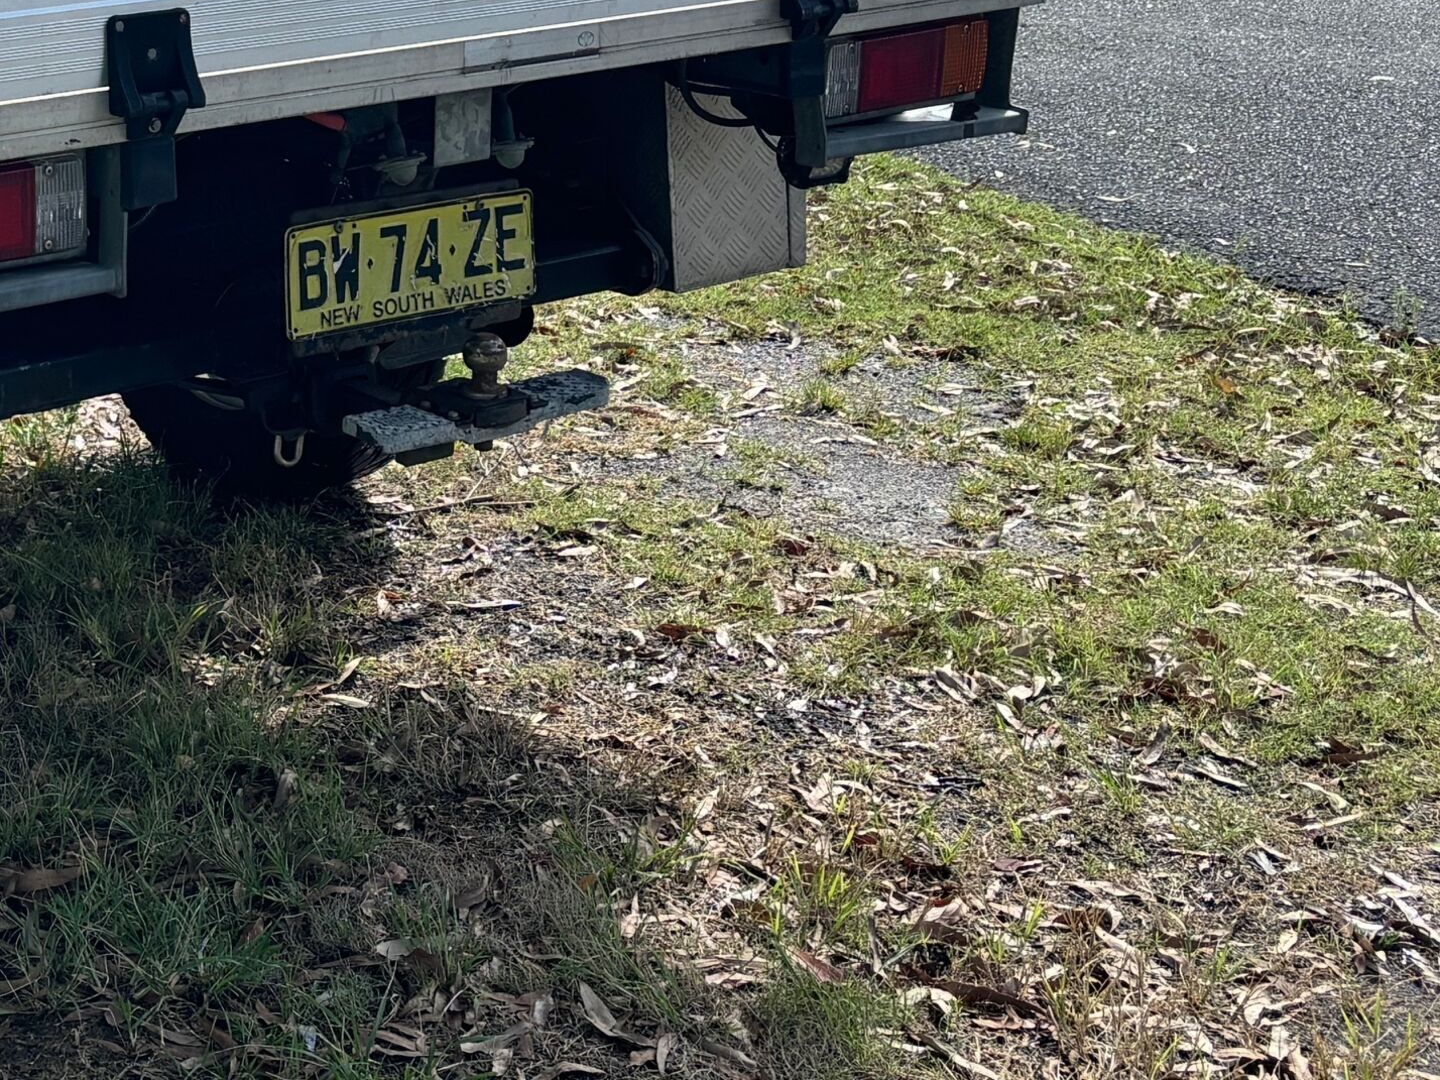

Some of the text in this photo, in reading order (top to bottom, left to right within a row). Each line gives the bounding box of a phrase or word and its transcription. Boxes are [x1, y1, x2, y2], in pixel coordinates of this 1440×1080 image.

[380, 218, 442, 293] 74
[462, 202, 526, 279] ZE
[320, 279, 507, 329] NEW SOUTH WALES
